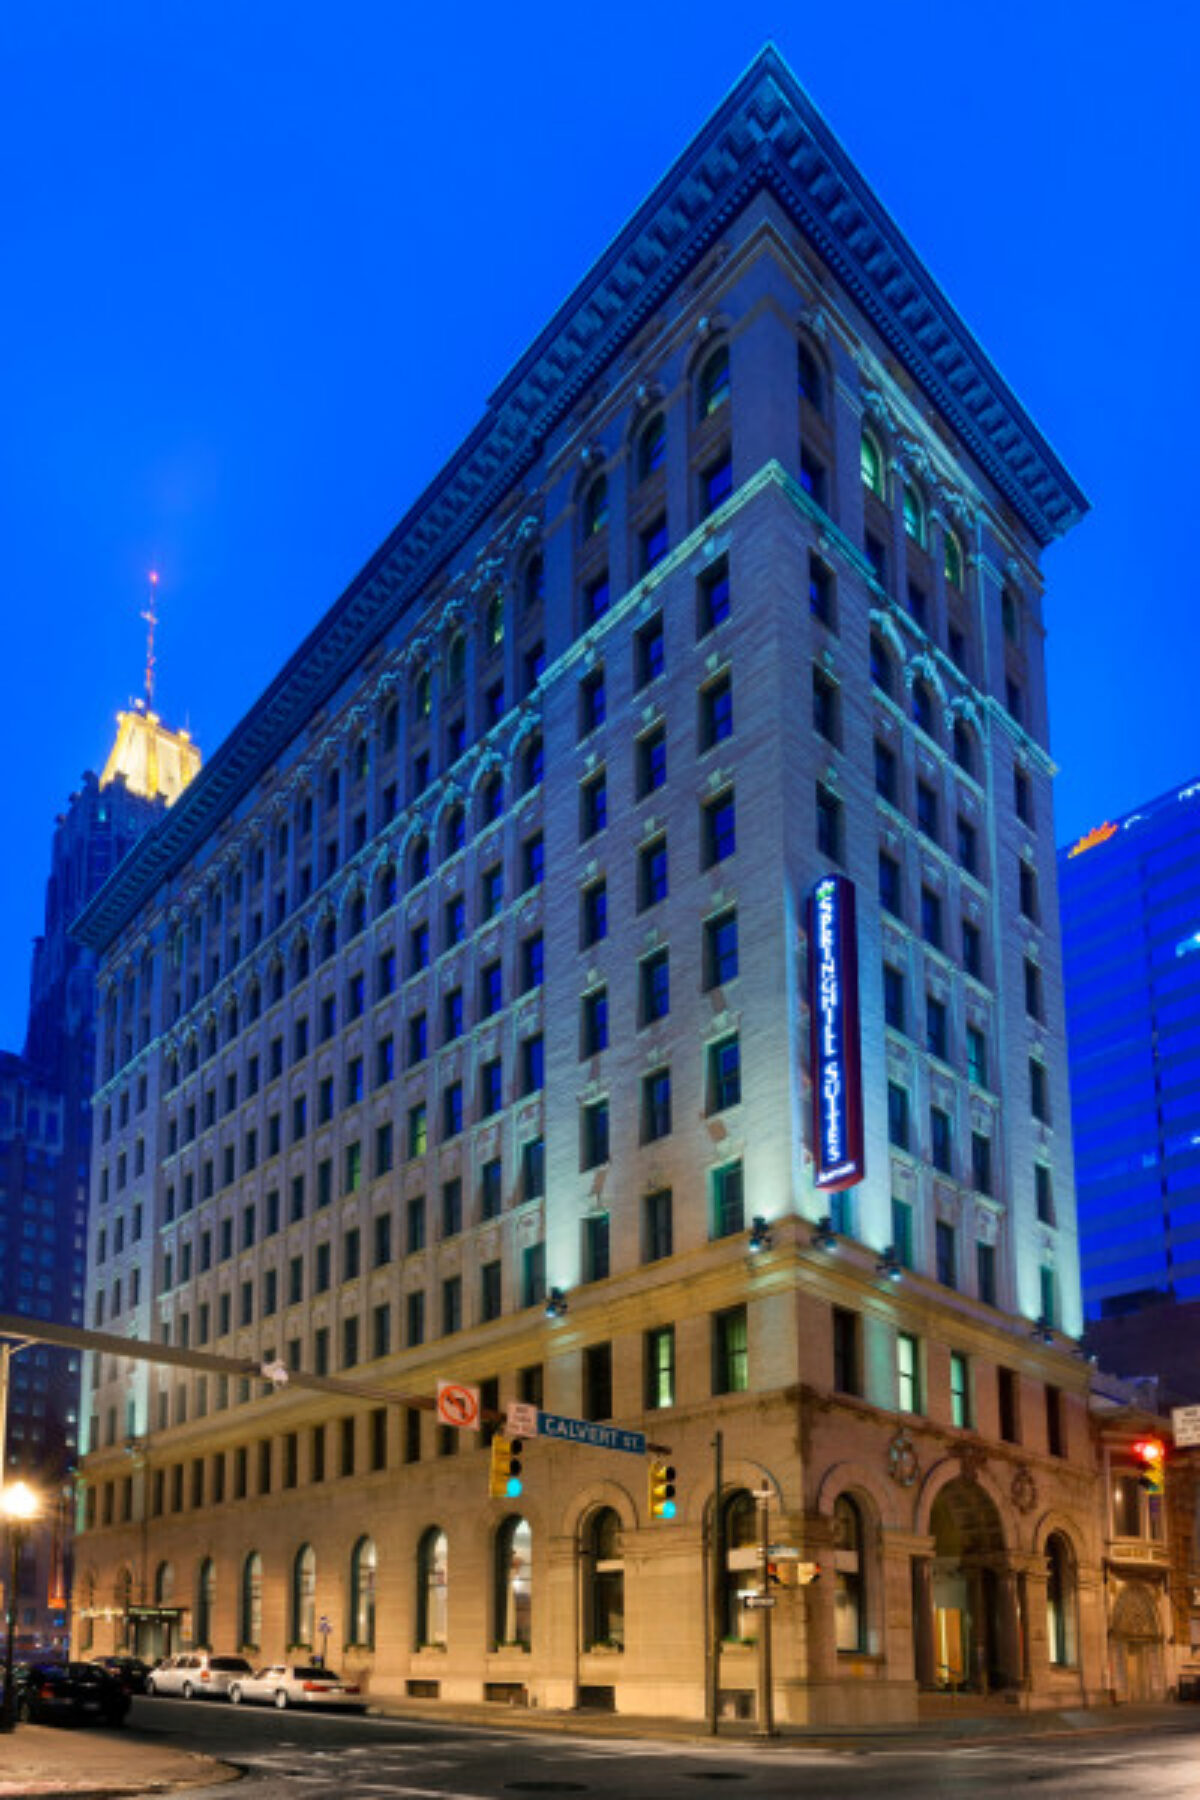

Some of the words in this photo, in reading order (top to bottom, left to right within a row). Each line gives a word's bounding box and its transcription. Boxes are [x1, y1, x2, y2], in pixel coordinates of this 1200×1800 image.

[824, 1061, 841, 1162] SUITES
[544, 1418, 619, 1447] CALVERT
[622, 1435, 639, 1450] ST
